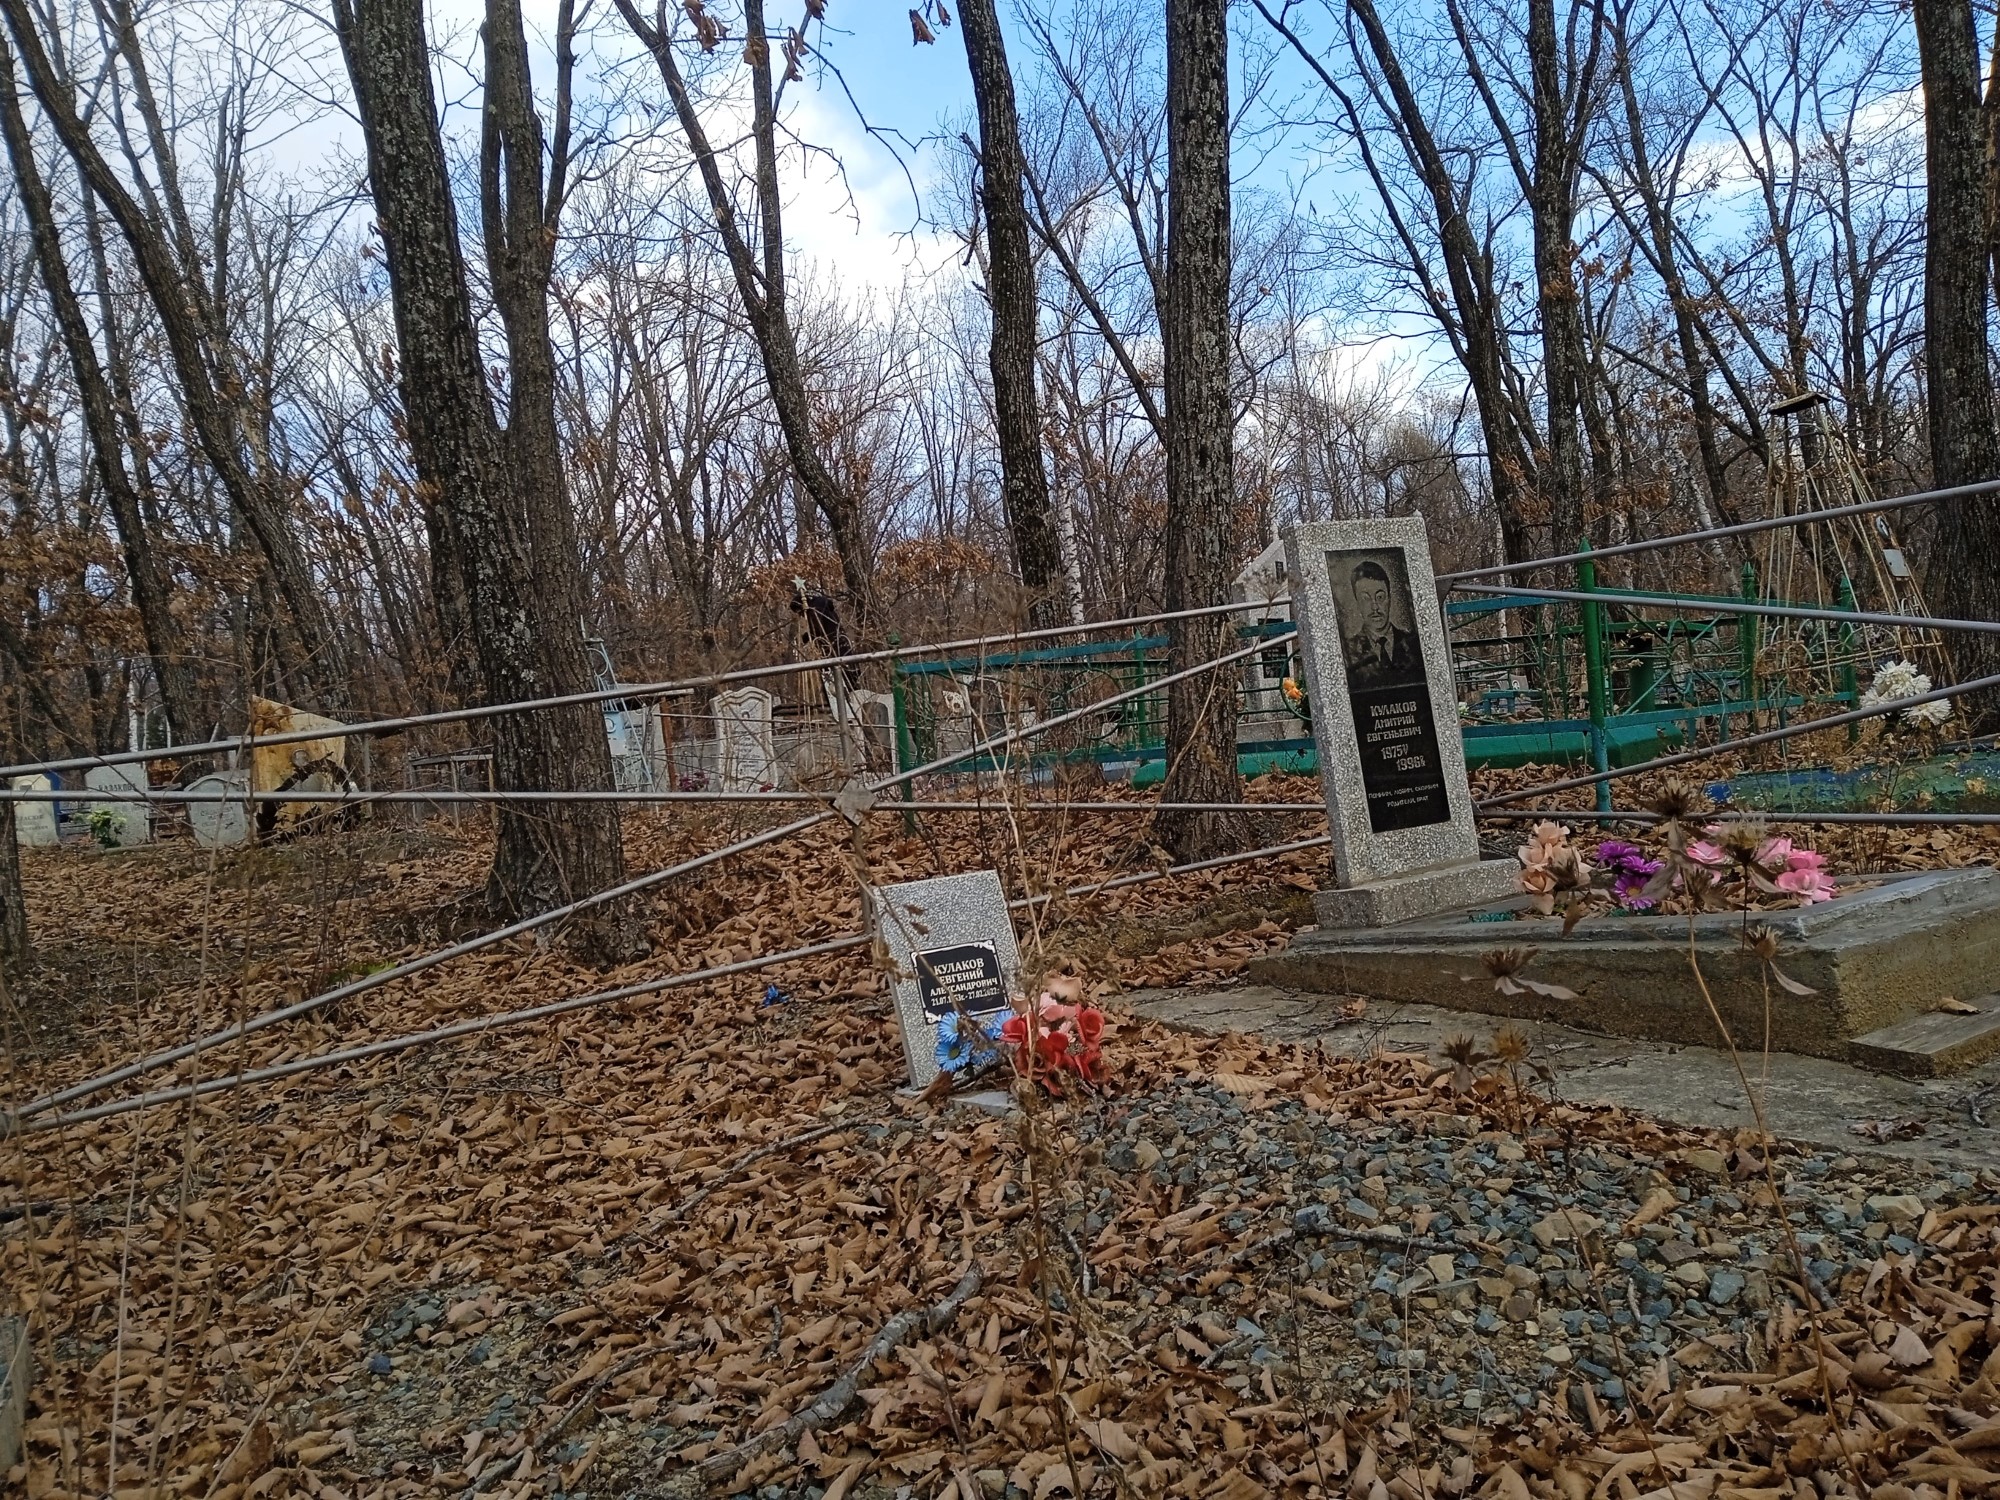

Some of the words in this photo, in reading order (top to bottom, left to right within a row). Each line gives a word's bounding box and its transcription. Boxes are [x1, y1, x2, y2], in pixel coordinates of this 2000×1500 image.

[1370, 701, 1418, 717] КУЛАКОВ
[1374, 713, 1415, 731] ДМИТРИЙ
[1366, 726, 1422, 743] ЕВГЕНЬЕВИЧ
[934, 958, 985, 976] КУЛАКОВ
[940, 968, 984, 985] ЕВГЕНИЙ
